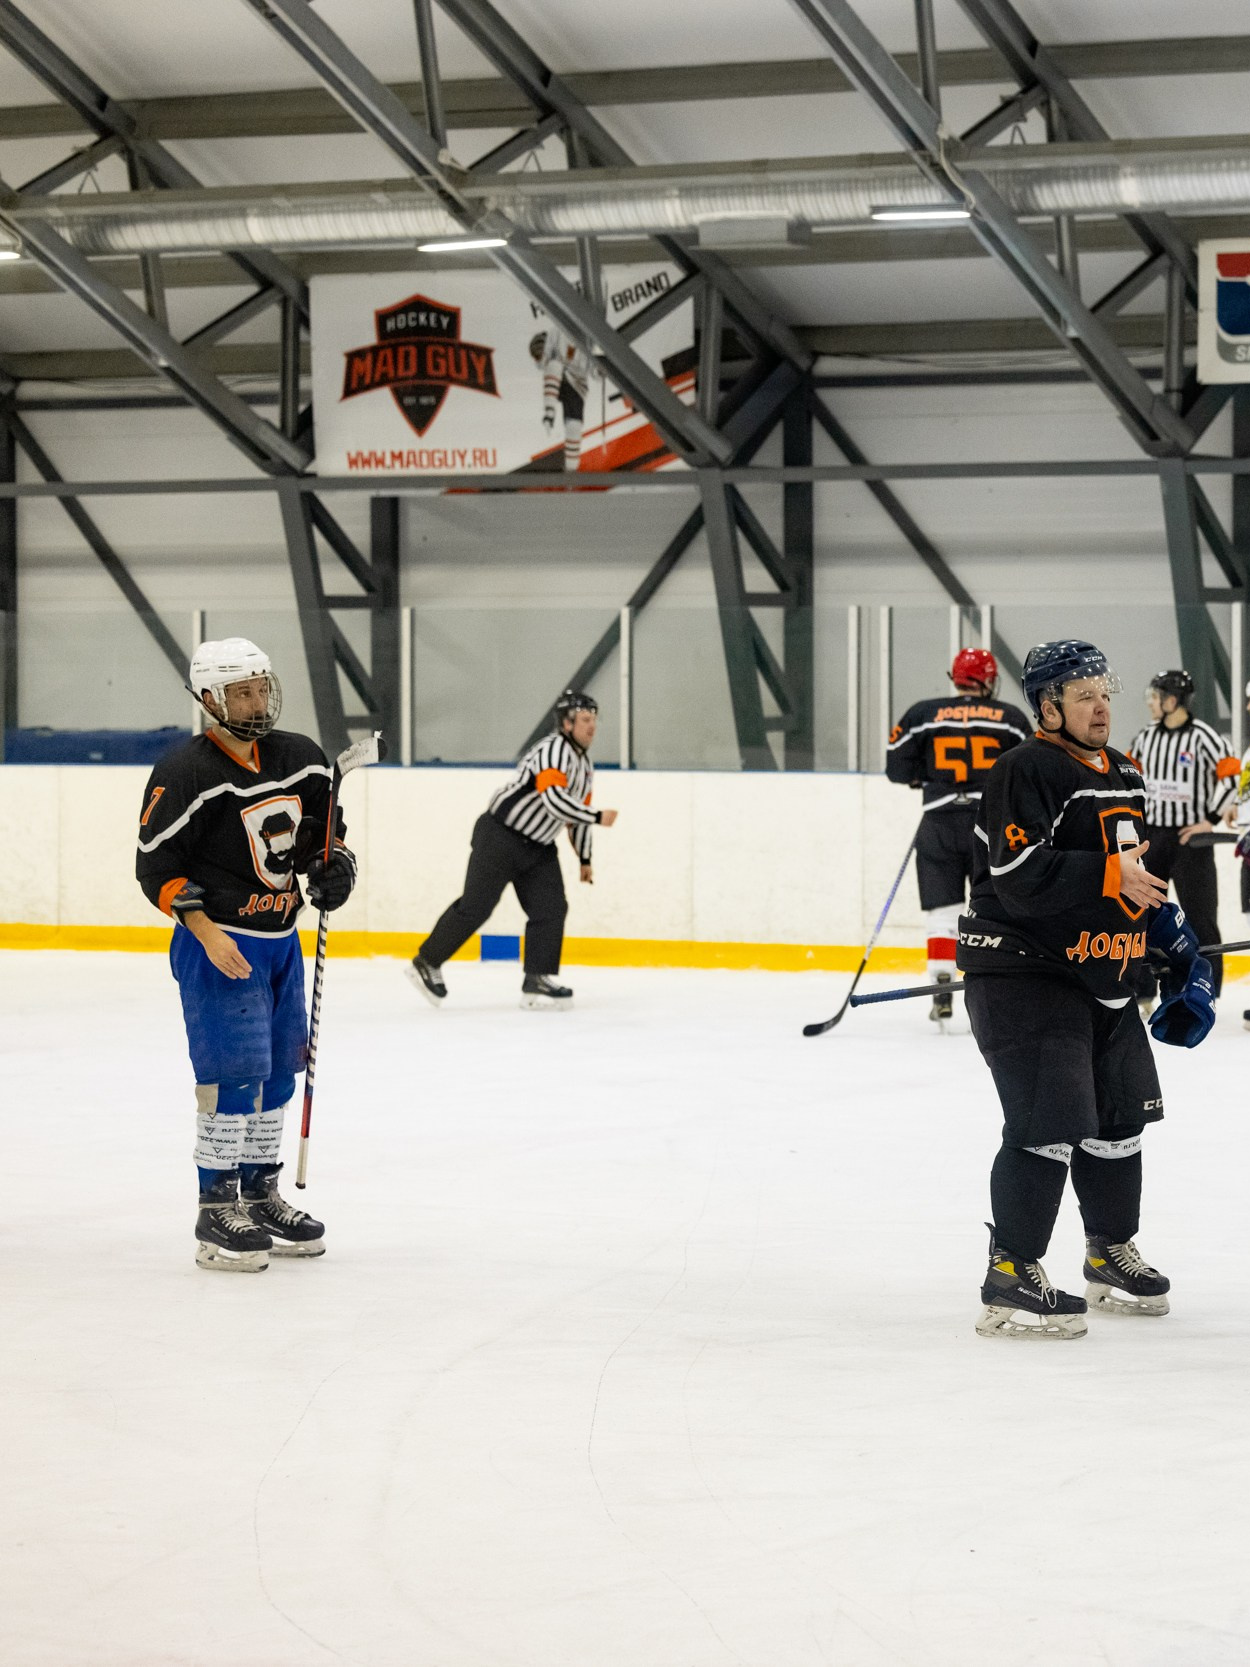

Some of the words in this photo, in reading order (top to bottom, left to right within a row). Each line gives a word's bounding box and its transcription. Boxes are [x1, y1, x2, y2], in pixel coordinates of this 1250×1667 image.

[611, 271, 673, 312] BRAND
[386, 311, 450, 333] HOCKEY
[350, 344, 418, 390] MAD
[426, 344, 489, 385] GUY
[347, 448, 498, 471] WWW.MADGUY.RU
[933, 736, 1001, 783] 55
[1005, 823, 1029, 851] 8
[959, 931, 1003, 949] CCM
